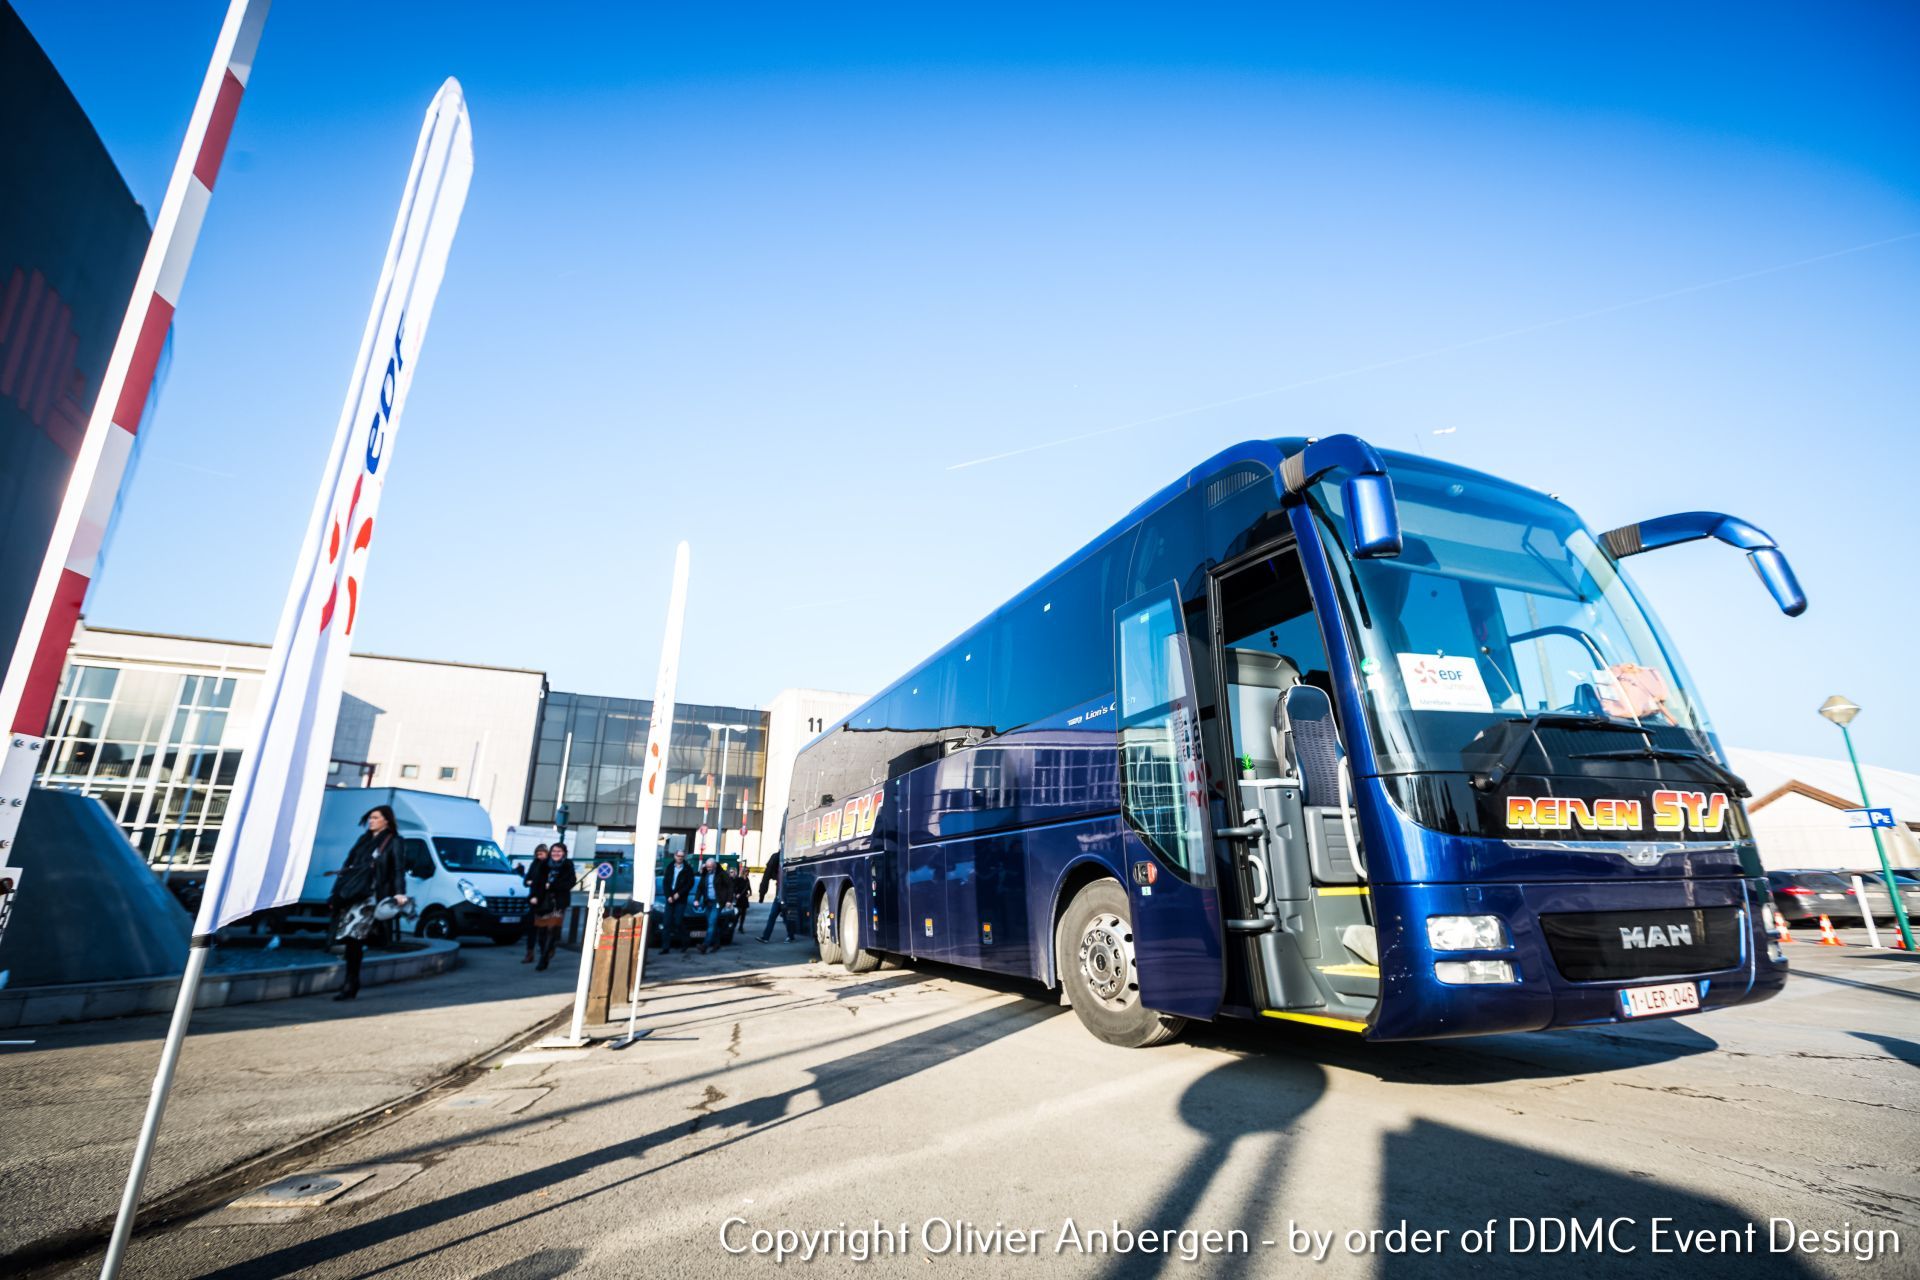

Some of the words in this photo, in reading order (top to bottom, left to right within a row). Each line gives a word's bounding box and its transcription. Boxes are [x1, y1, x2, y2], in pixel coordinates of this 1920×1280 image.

[808, 717, 823, 733] 11
[1085, 705, 1108, 720] Lion's
[840, 788, 885, 842] SYS
[1653, 789, 1730, 833] SYS
[1619, 924, 1694, 950] MAN
